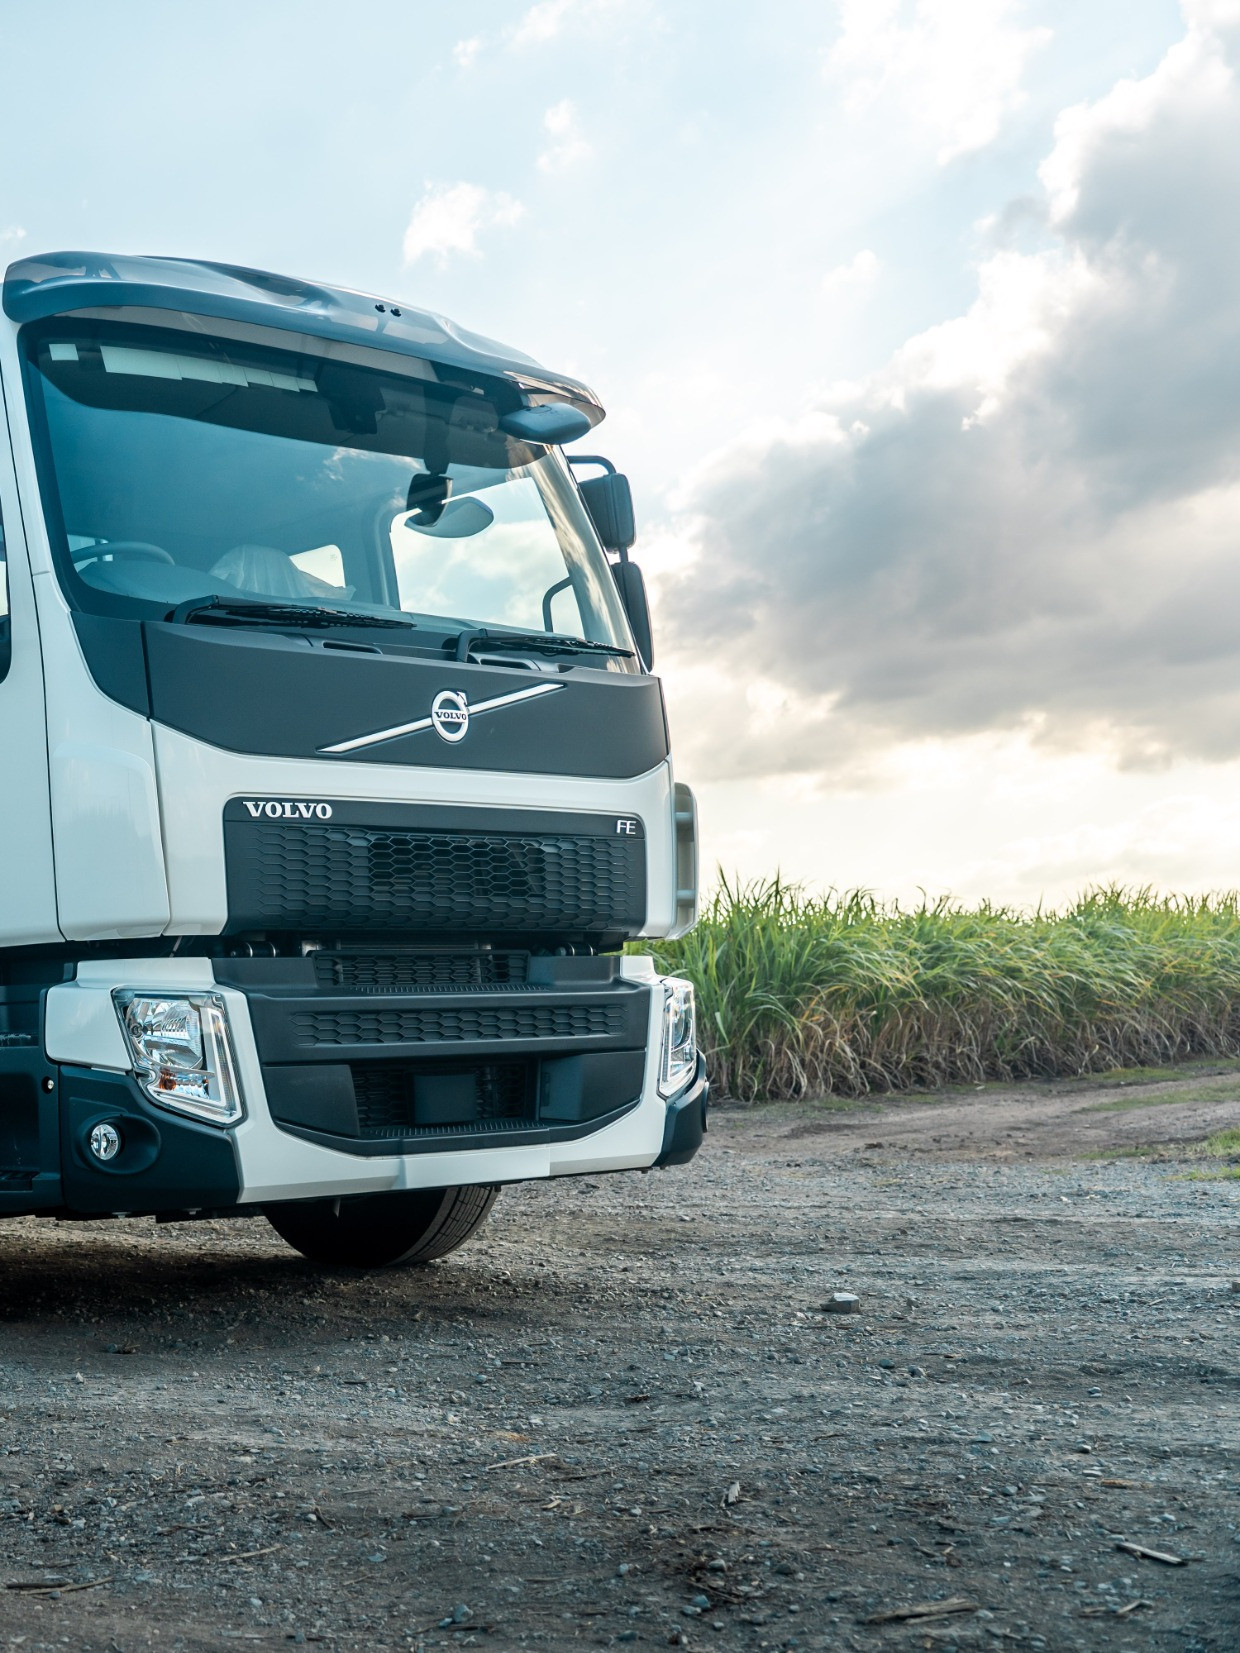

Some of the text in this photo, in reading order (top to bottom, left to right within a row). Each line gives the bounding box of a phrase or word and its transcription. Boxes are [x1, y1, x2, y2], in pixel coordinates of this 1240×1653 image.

[434, 711, 467, 720] VOLVO
[242, 801, 333, 819] VOLVO
[616, 819, 637, 835] FE
